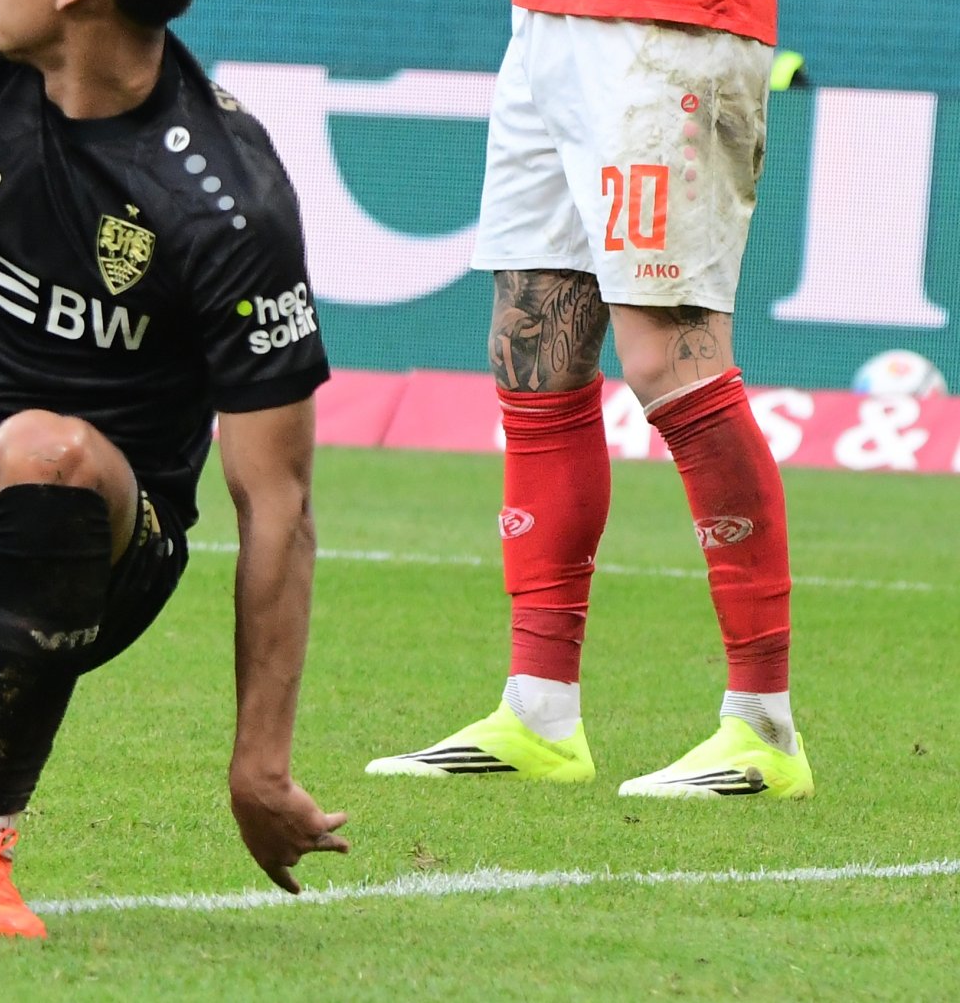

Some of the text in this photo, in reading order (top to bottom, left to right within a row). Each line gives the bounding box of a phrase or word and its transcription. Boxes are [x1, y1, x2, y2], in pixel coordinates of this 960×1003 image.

[601, 164, 669, 252] 20
[635, 263, 680, 279] JAKO
[254, 281, 308, 326] hep
[248, 306, 318, 355] solar
[833, 395, 930, 471] &
